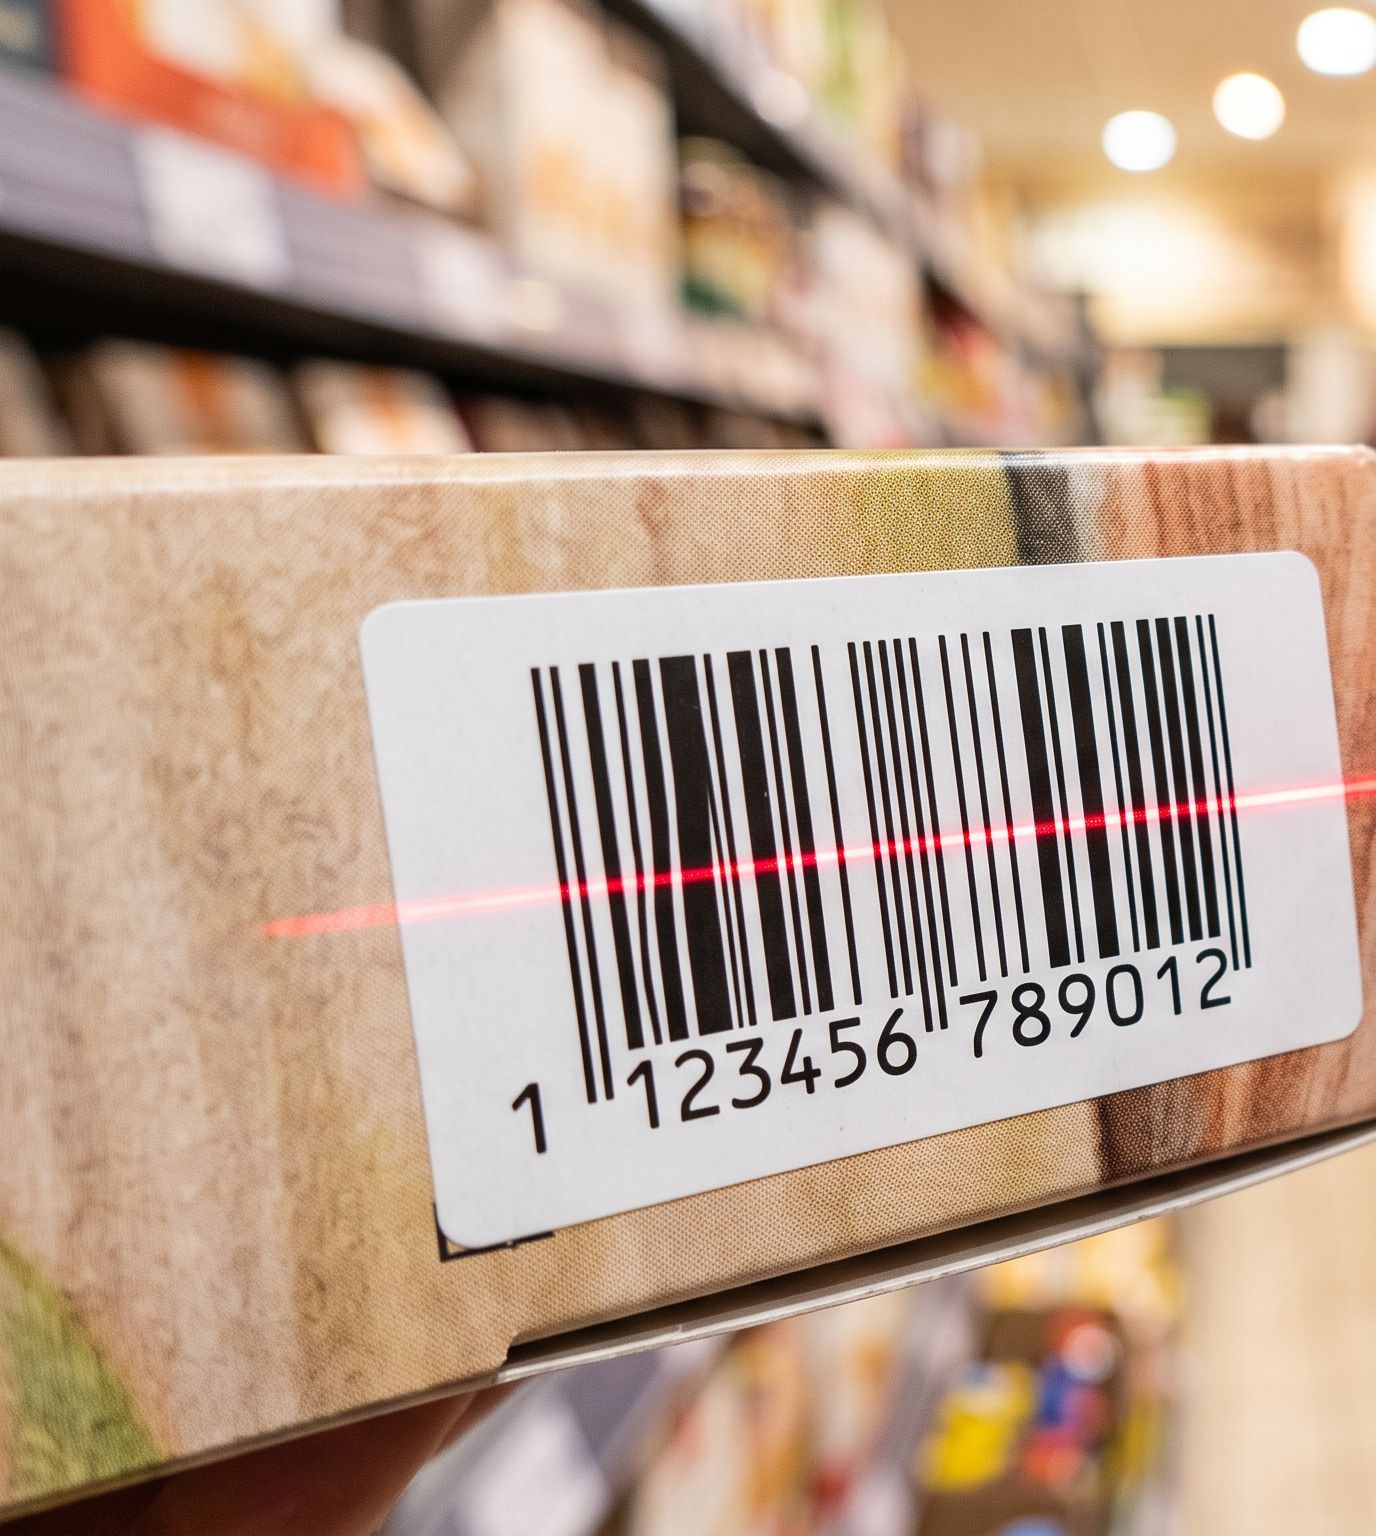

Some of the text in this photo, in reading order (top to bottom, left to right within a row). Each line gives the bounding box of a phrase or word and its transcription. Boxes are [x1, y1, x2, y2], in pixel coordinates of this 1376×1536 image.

[511, 948, 1232, 1154] 1 123456 789012
